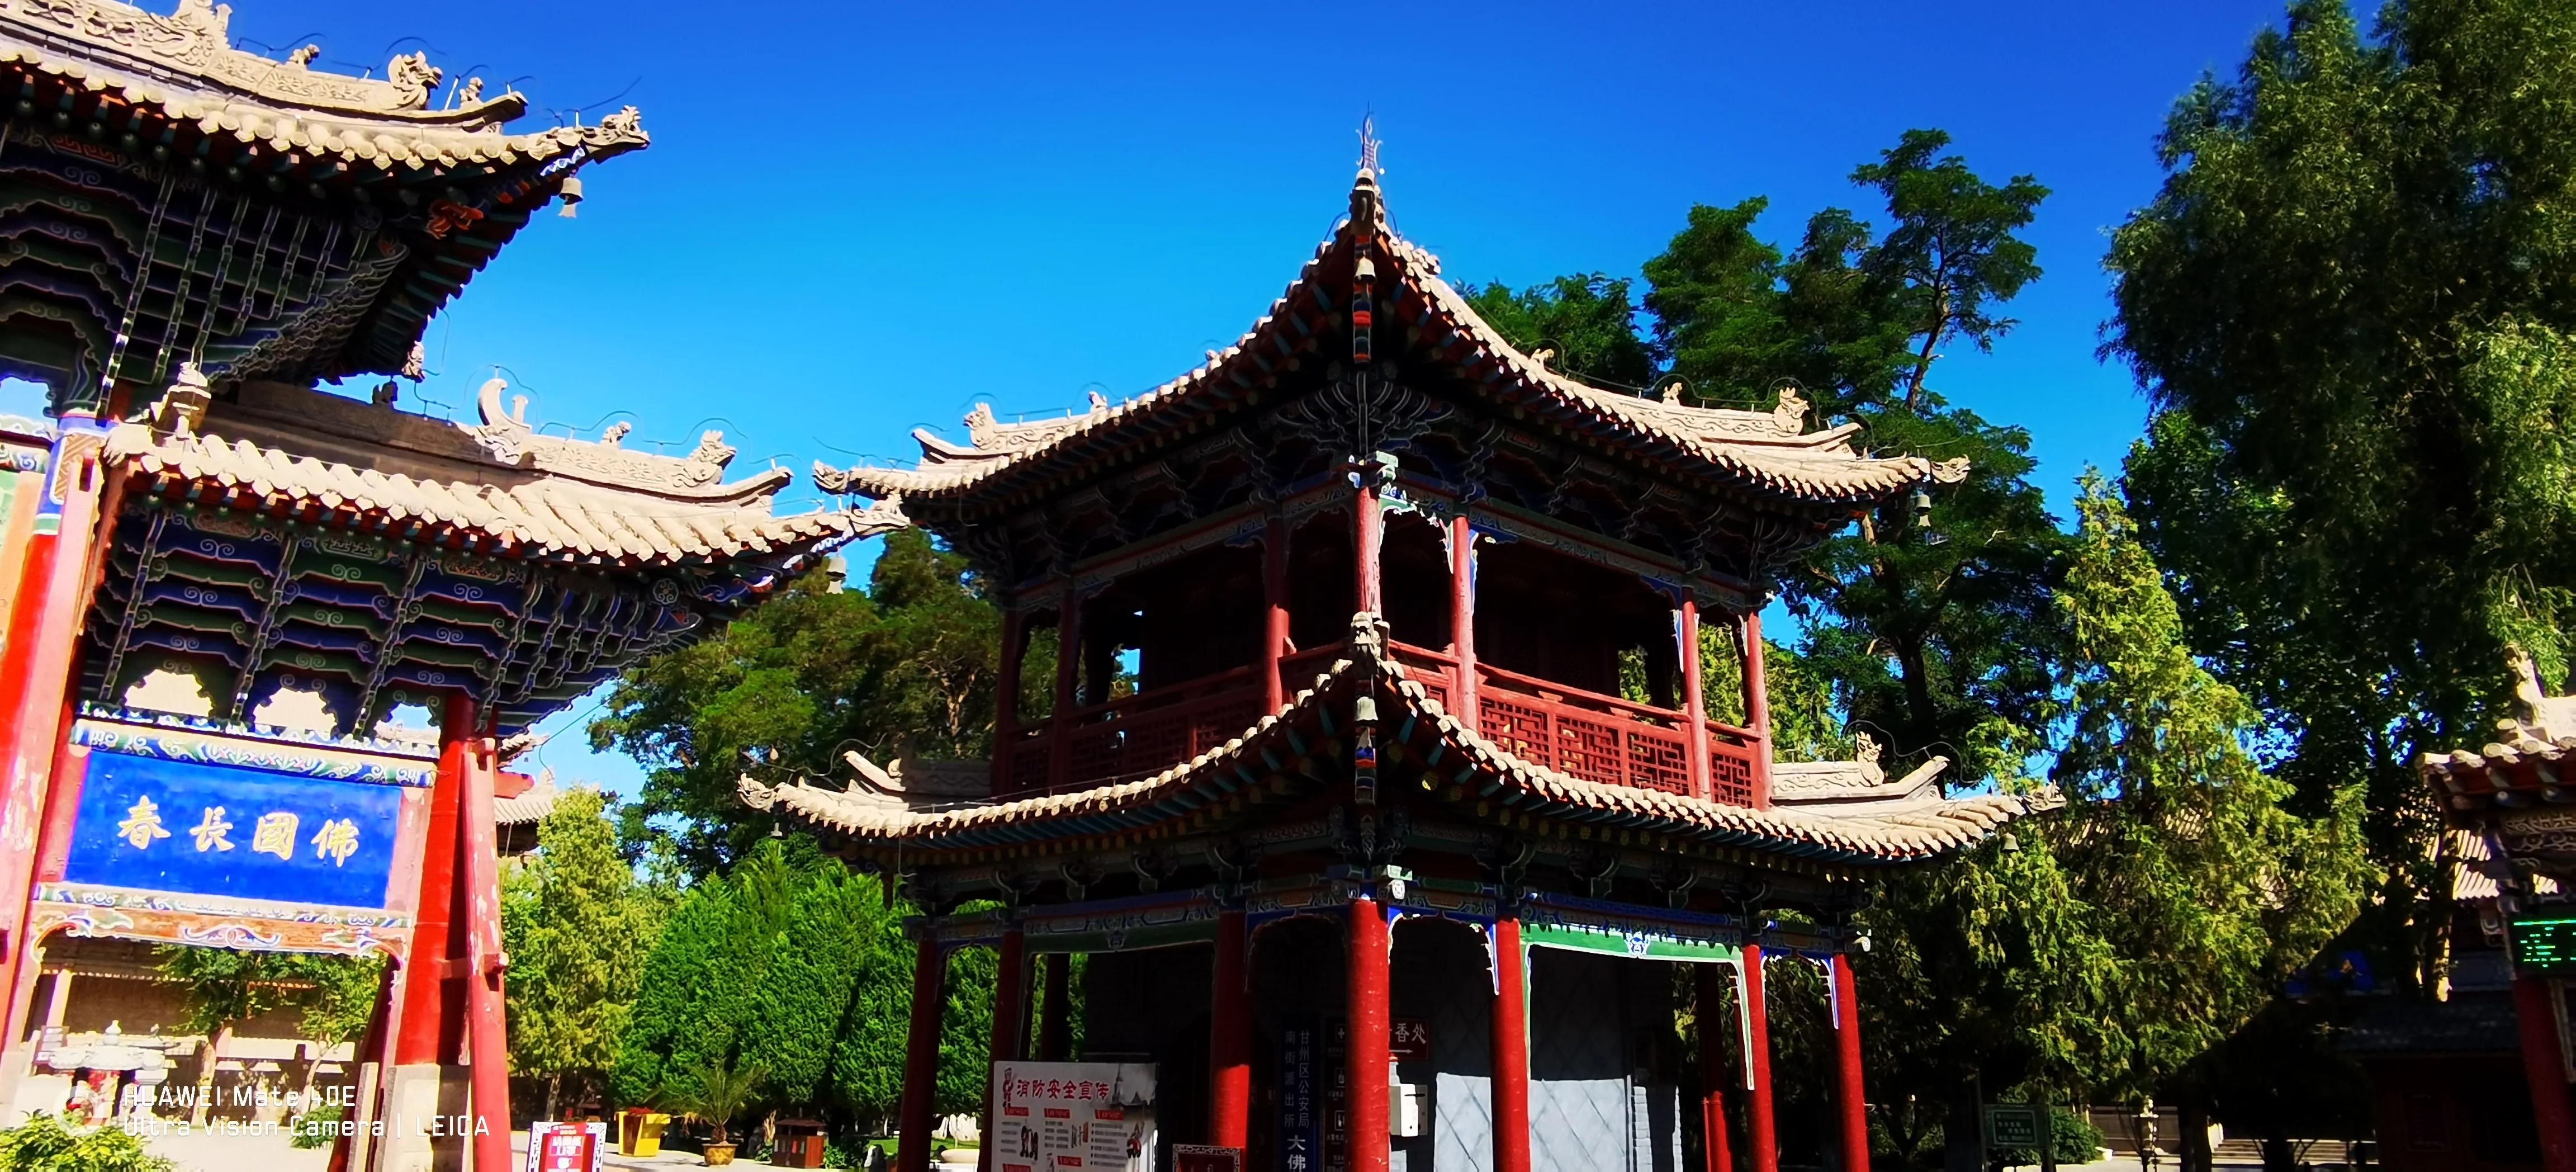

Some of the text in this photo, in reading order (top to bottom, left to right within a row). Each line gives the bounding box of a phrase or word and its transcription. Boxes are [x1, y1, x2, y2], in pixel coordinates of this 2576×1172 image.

[1389, 1023, 1427, 1045] 香处
[1016, 1079, 1110, 1101] 消防安全宣传
[1284, 1029, 1296, 1128] 南街派出所
[1298, 1029, 1311, 1130] 甘州区公安局
[1287, 1134, 1306, 1172] 大佛
